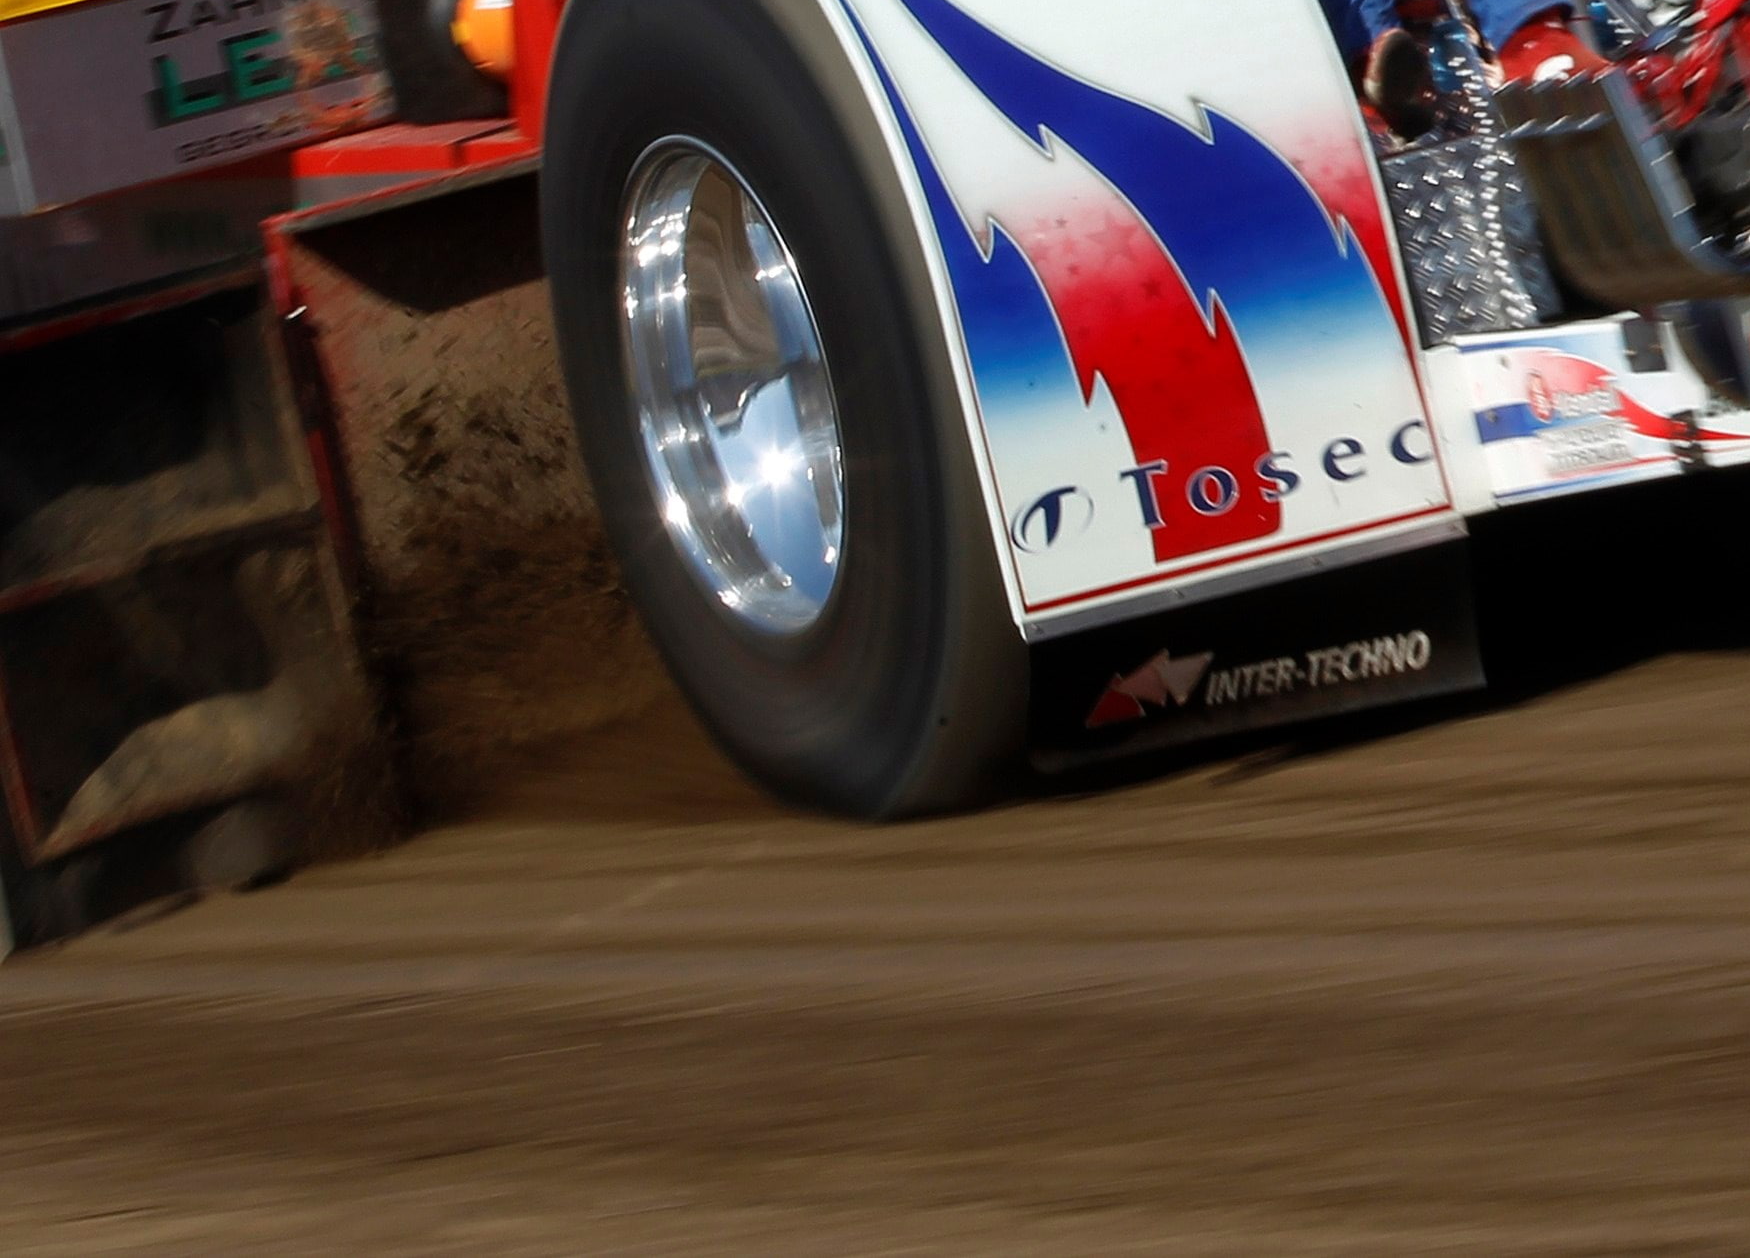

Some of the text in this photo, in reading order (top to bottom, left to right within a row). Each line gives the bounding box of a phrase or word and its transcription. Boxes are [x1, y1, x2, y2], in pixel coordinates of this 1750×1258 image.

[144, 29, 378, 127] LE
[1119, 419, 1434, 529] Tosec
[1205, 629, 1431, 705] INTER-TECHNO
